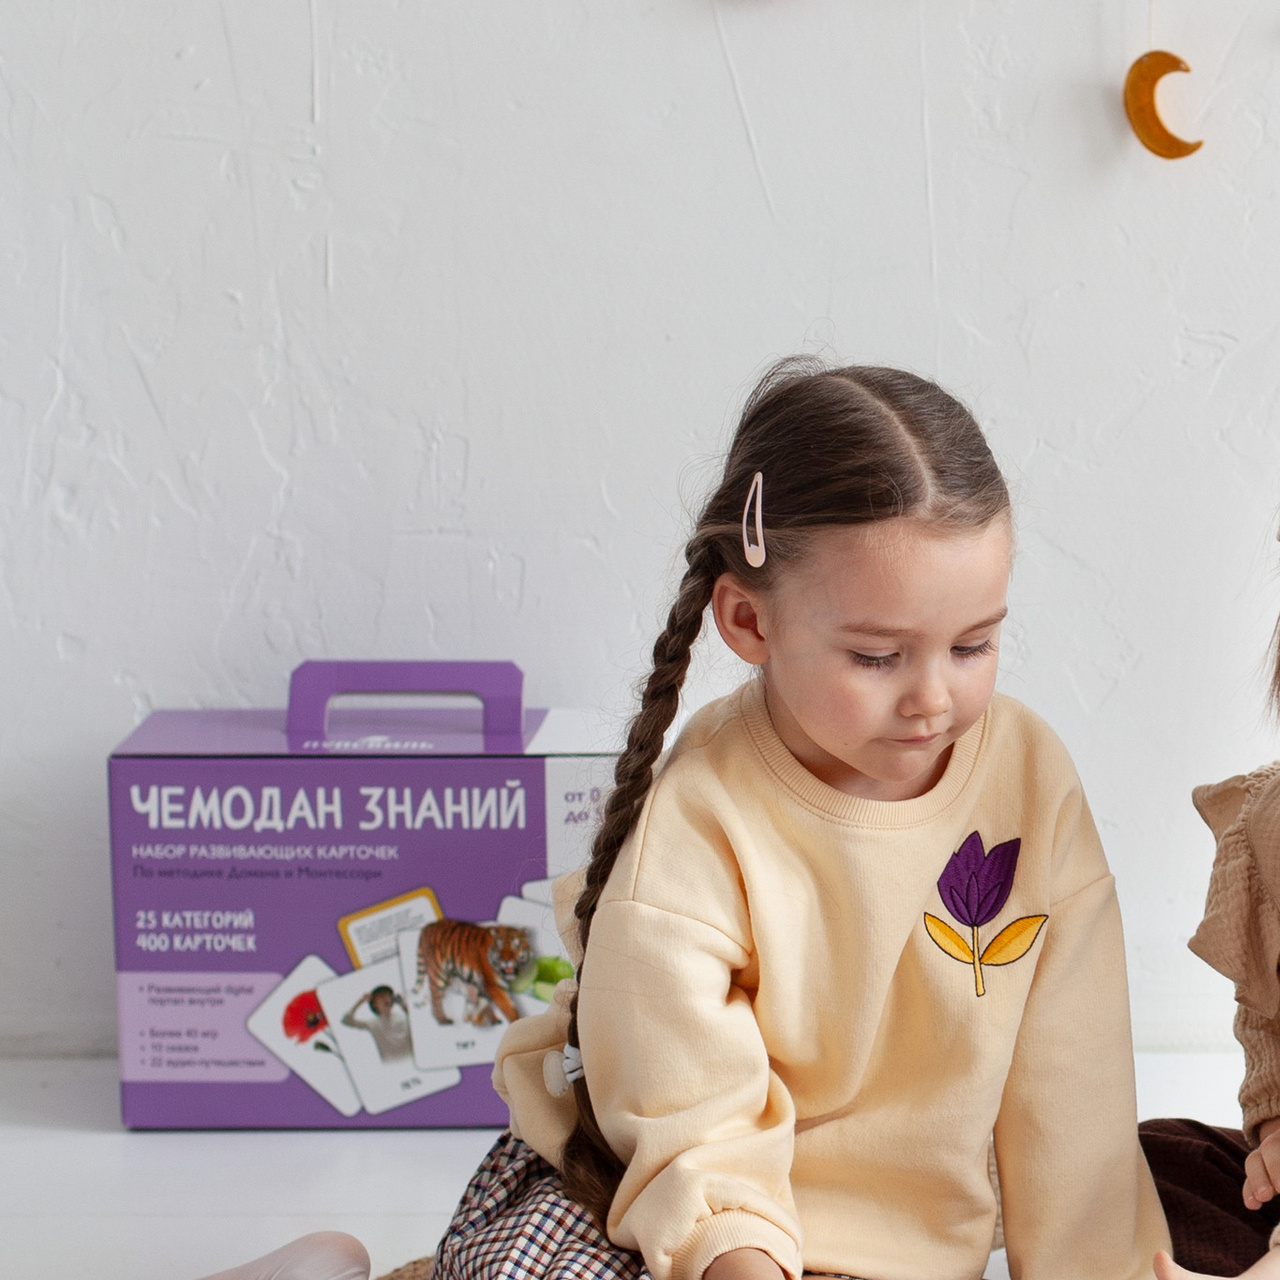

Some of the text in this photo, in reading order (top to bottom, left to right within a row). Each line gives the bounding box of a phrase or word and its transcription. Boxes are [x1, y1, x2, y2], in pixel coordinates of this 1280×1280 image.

[129, 779, 526, 833] ЧЕМОДАН ЗНАНИЙ
[564, 792, 584, 803] от
[131, 843, 399, 861] НАБОР РАЗВИВАЮЩИХ КАРТОЧЕК
[136, 908, 255, 929] 25 КАТЕГОРИЙ
[136, 933, 257, 952] 400 КАРТОЧЕК
